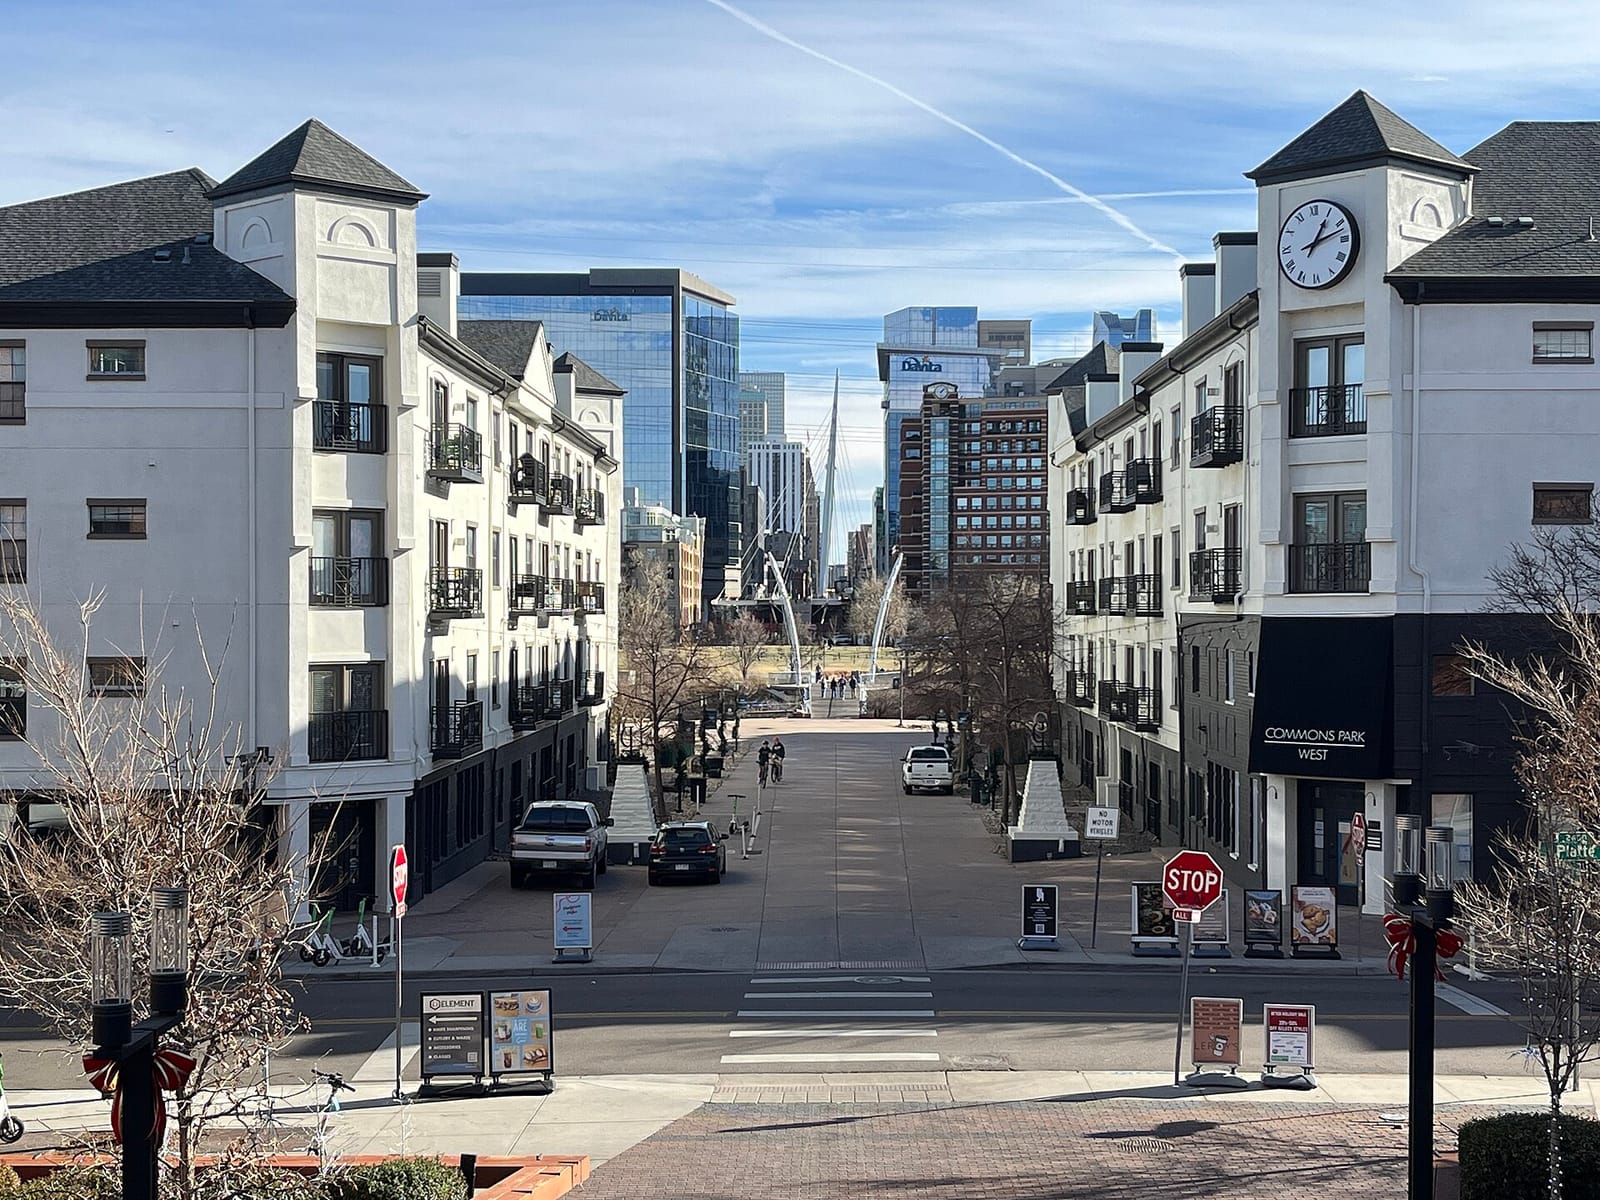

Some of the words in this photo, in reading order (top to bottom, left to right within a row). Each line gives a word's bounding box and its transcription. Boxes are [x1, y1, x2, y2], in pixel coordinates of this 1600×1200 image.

[901, 357, 942, 372] DaVita
[1265, 727, 1335, 741] COMMONS
[1338, 731, 1366, 742] PARK
[1298, 748, 1328, 760] WEST
[1556, 844, 1595, 858] Platte
[1167, 868, 1218, 893] STOP
[1175, 911, 1188, 920] ALL
[441, 1000, 475, 1008] ELEMENT
